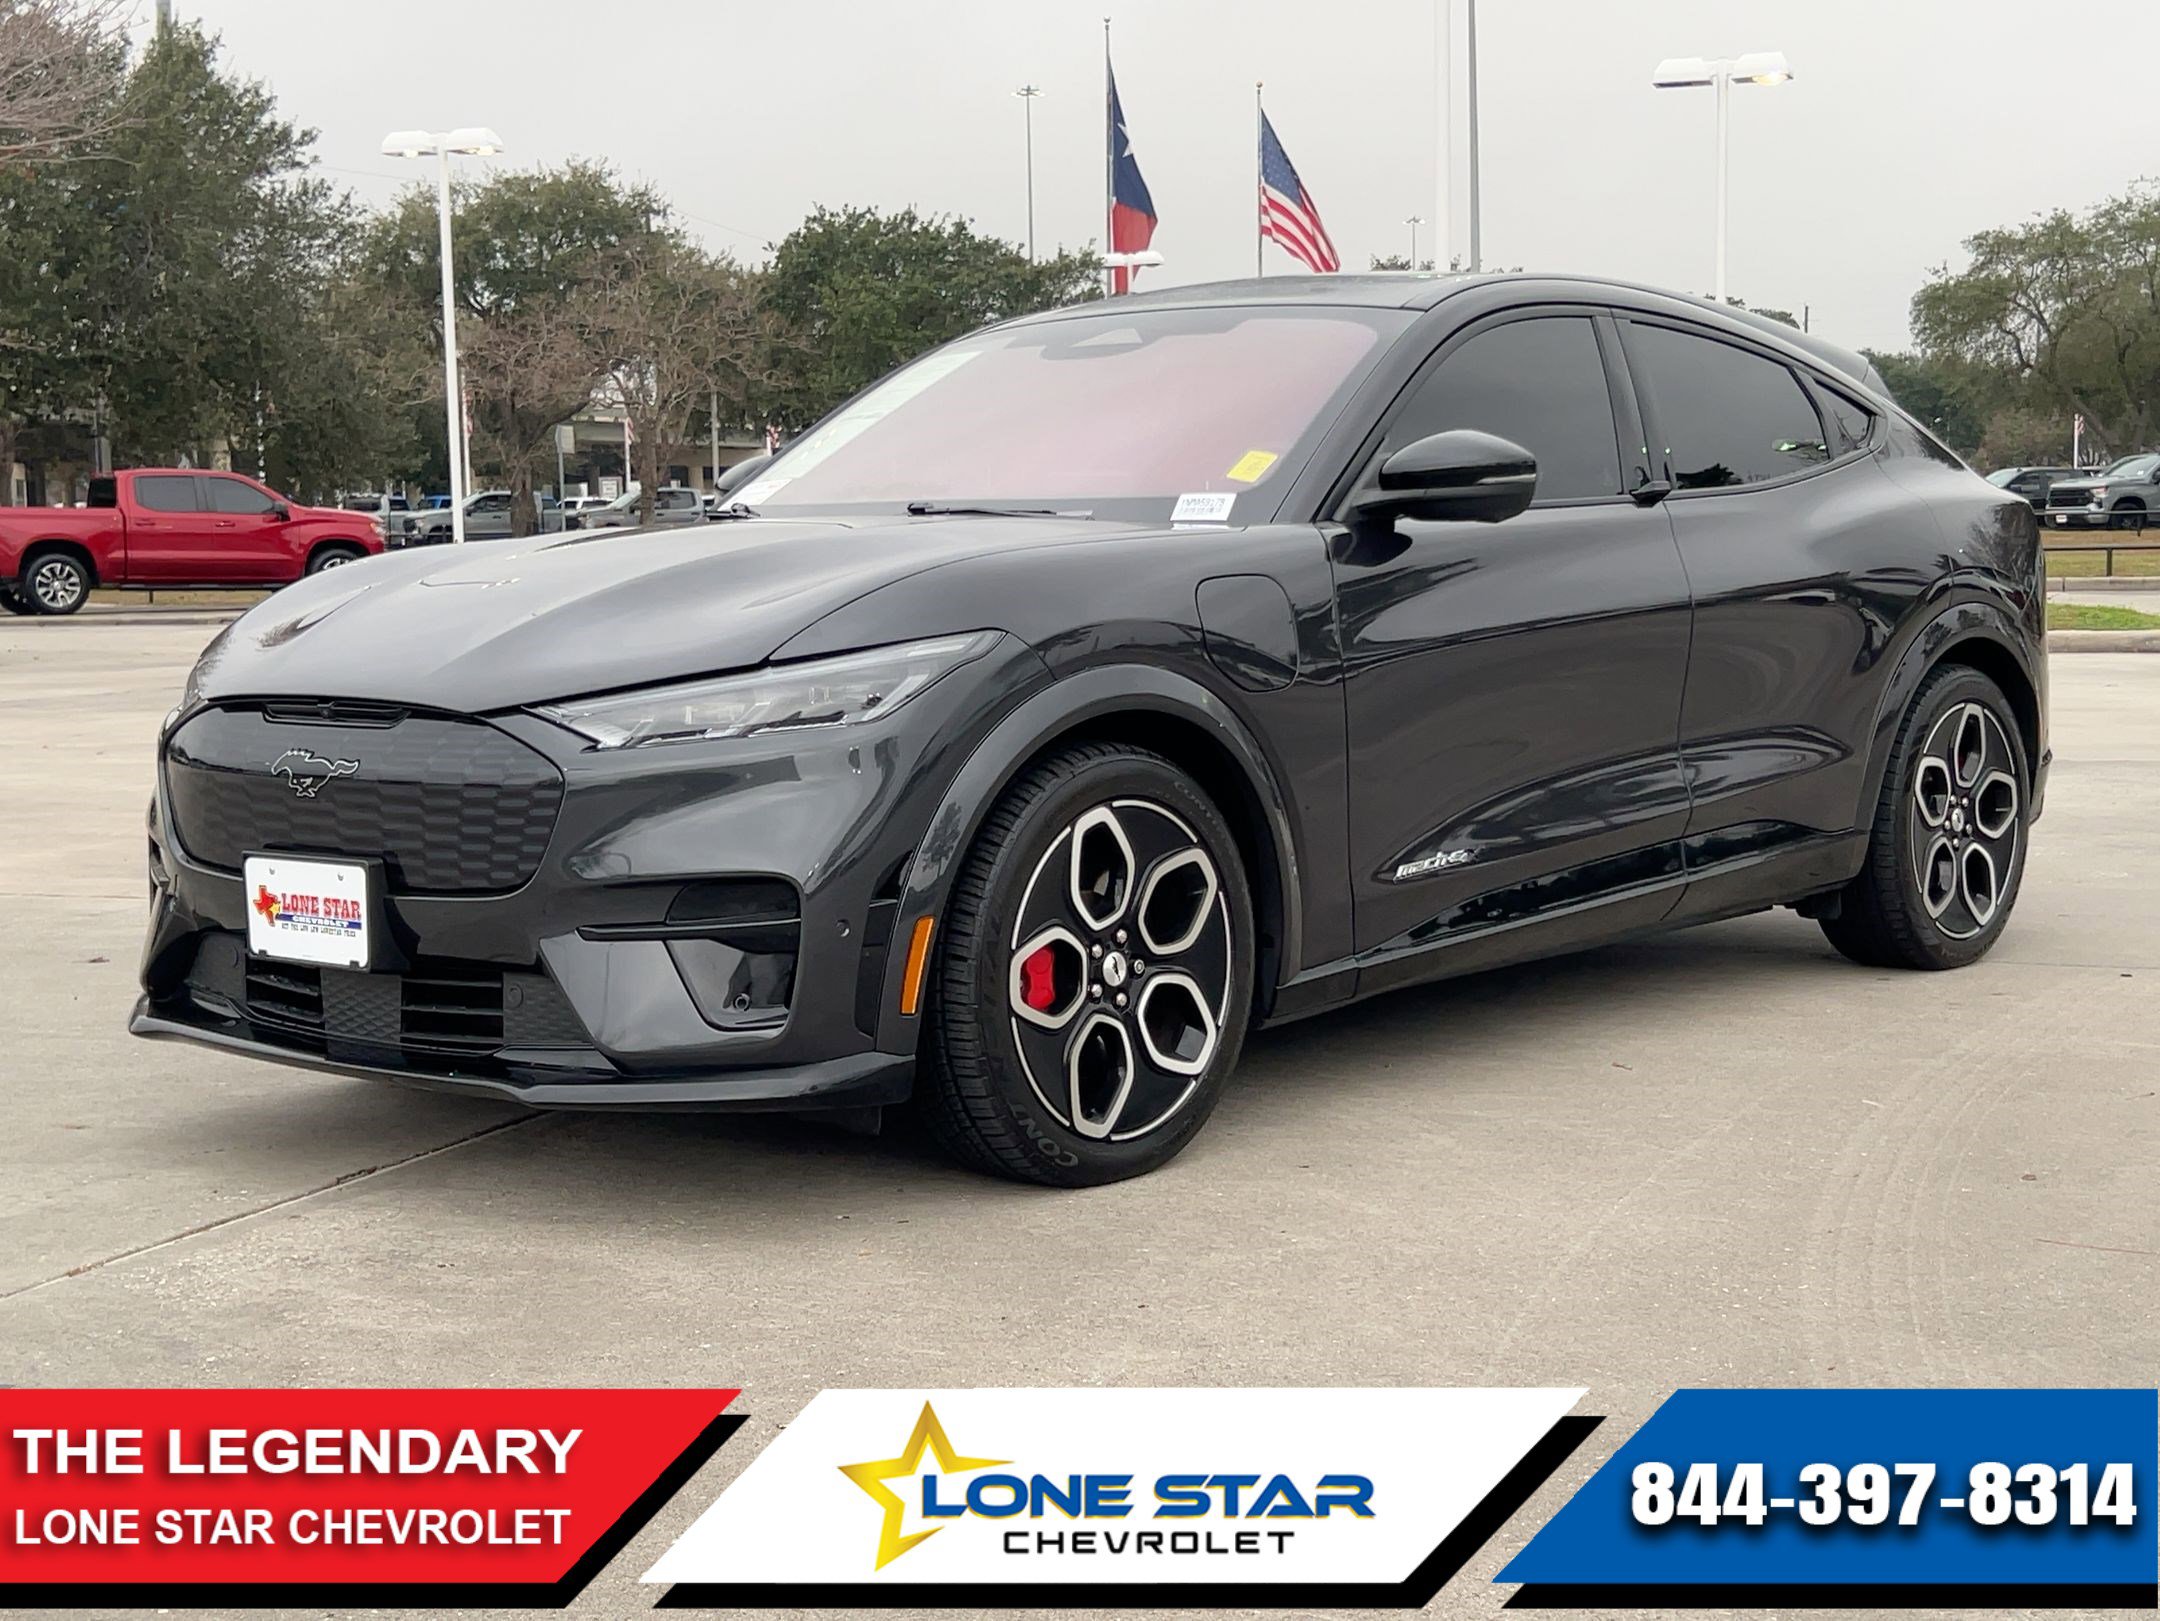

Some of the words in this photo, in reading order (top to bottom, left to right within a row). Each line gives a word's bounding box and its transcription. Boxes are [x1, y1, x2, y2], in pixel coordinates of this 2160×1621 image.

[281, 893, 320, 916] LONE
[323, 897, 362, 920] STAR
[292, 915, 350, 928] CHEVROLET
